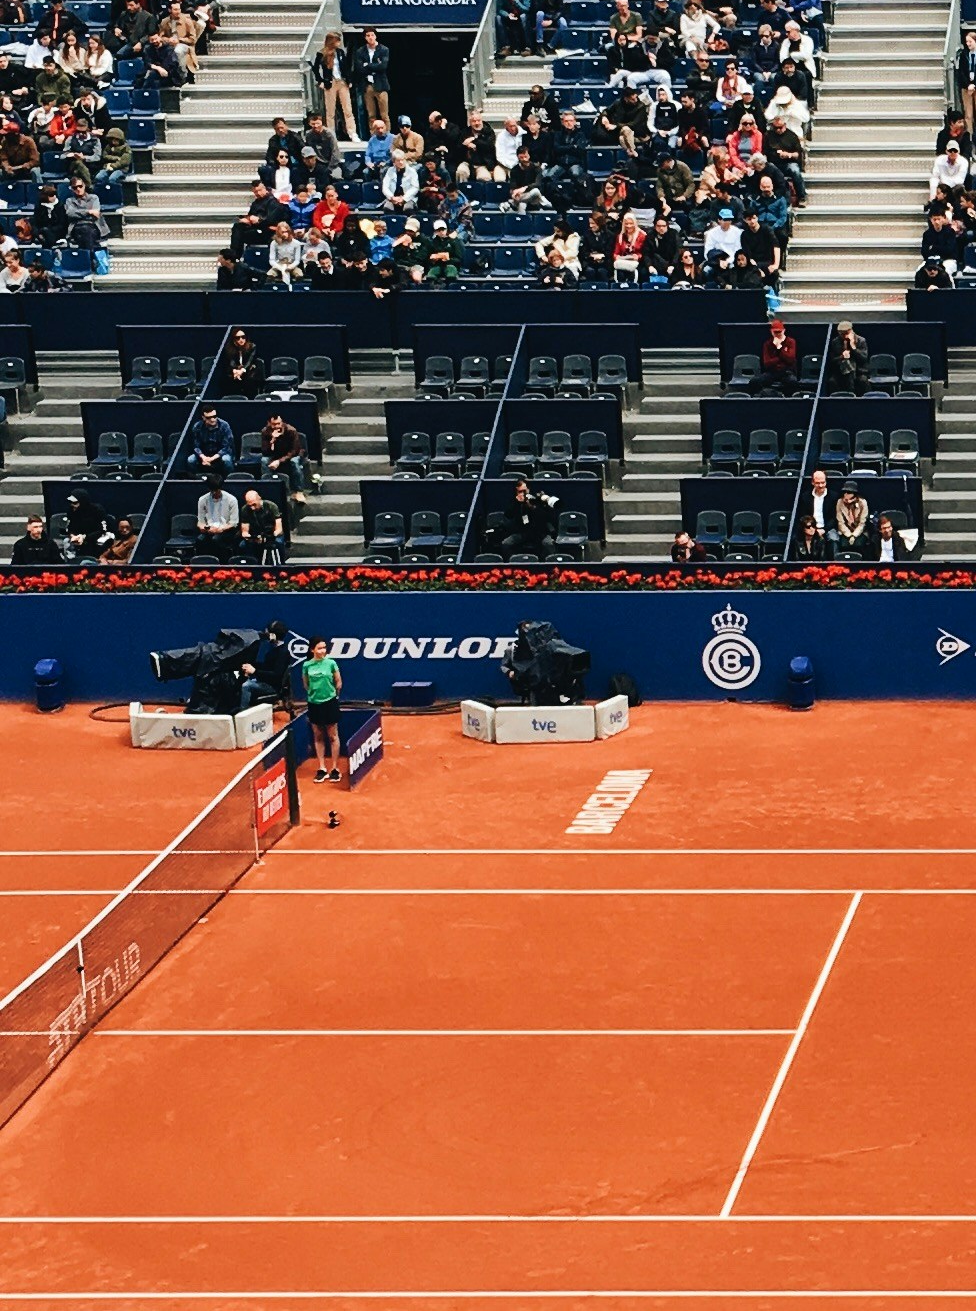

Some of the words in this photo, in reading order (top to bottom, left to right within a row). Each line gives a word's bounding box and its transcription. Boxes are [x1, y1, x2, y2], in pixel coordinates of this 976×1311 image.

[467, 713, 481, 732] tve
[609, 710, 623, 725] tve
[171, 725, 197, 741] tve
[251, 720, 267, 734] tve
[531, 718, 557, 734] tve
